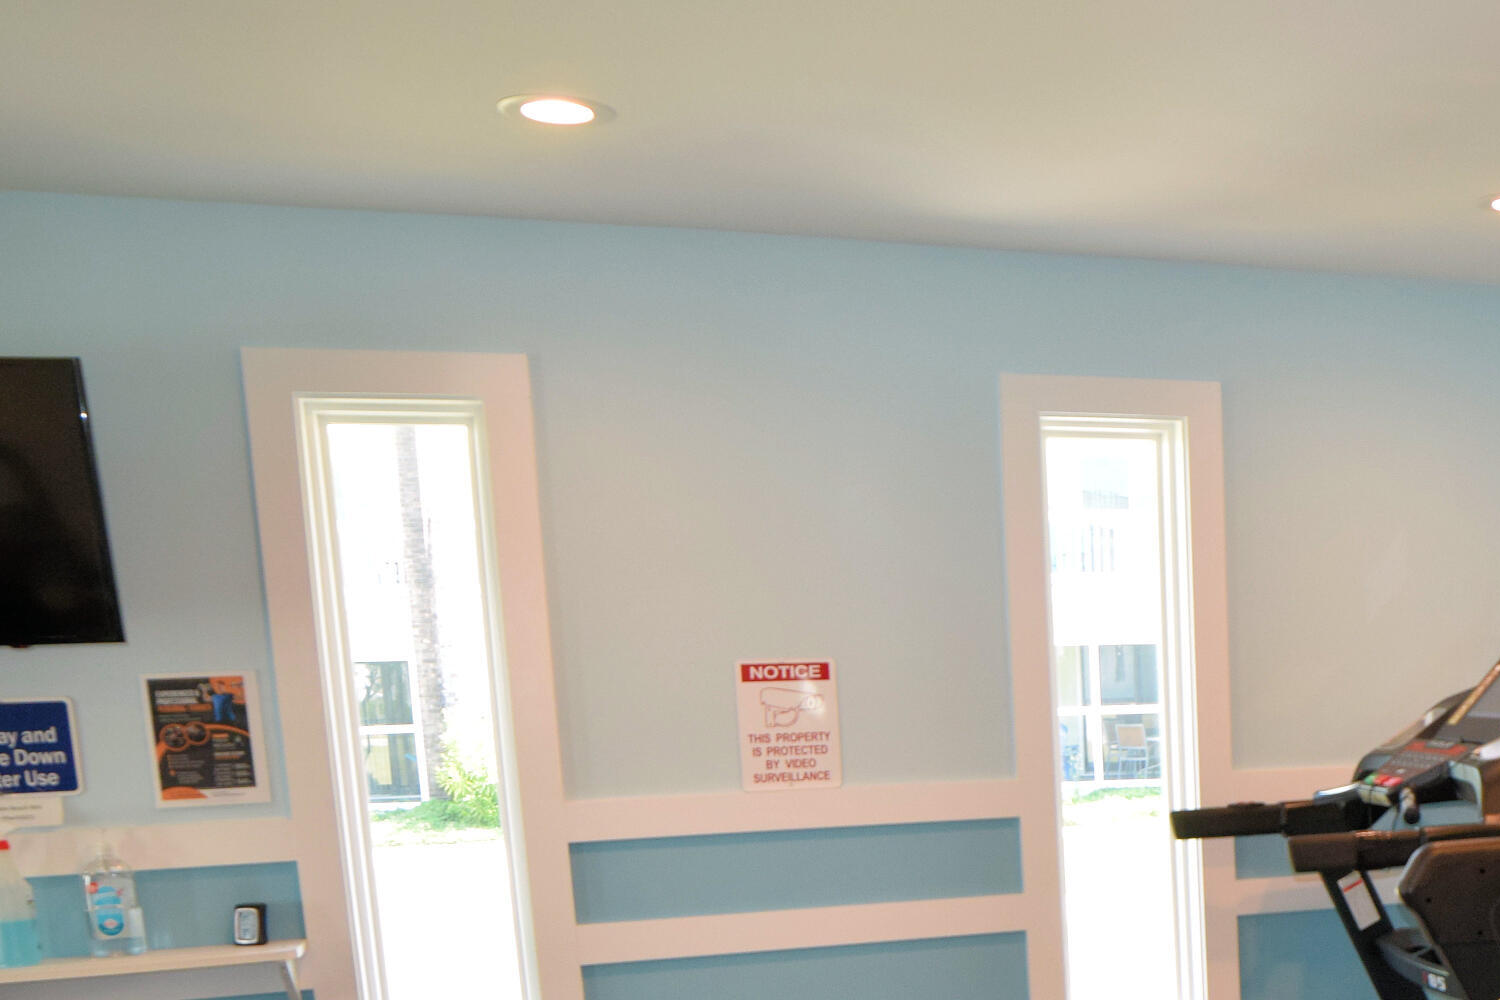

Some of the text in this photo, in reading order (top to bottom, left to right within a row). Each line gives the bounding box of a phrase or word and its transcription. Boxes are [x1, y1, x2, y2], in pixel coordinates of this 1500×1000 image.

[749, 664, 821, 680] NOTICE
[21, 726, 58, 744] and
[748, 731, 831, 744] THIS PROPERTY
[13, 748, 67, 766] Down
[752, 745, 829, 757] IS PROTECTED
[765, 758, 817, 770] BY VIDEO
[24, 769, 60, 787] Use
[753, 770, 831, 784] SURVEILLANCE
